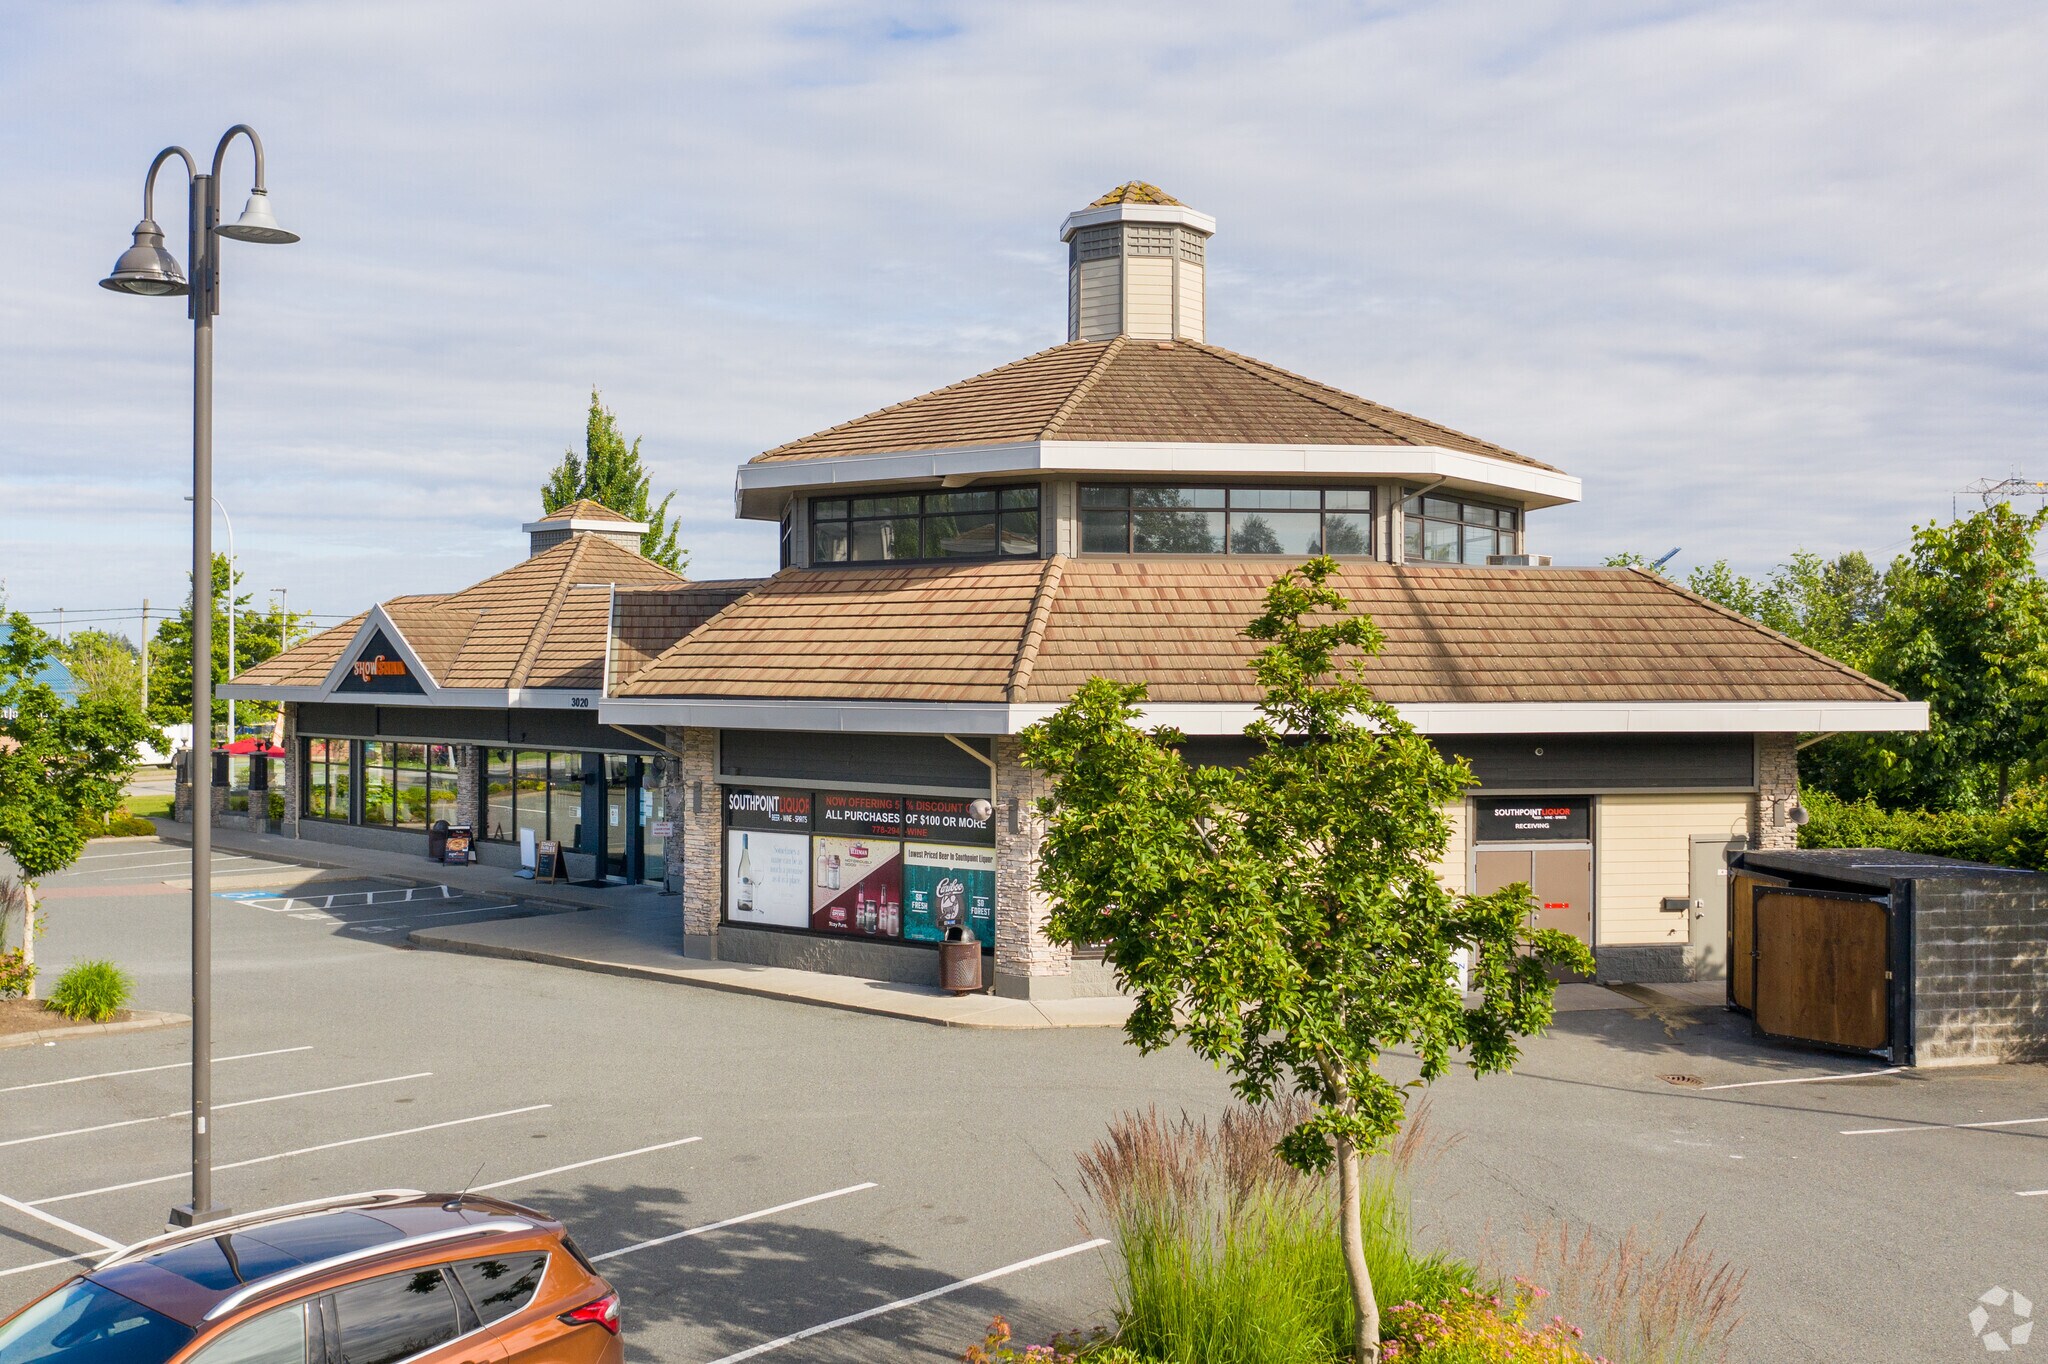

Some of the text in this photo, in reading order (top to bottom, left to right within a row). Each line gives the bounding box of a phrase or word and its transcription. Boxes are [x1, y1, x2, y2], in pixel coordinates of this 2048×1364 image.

[571, 697, 589, 707] 3020
[826, 796, 846, 807] NOW
[848, 797, 892, 809] OFFERING
[916, 801, 963, 813] DISCOUNT
[825, 809, 987, 829] ALL PURCHASES OF $100 OR MORE
[908, 849, 923, 858] Lowest
[924, 851, 938, 860] Priced
[939, 852, 949, 860] Beer
[955, 853, 978, 862] Southpoint
[979, 854, 993, 864] Liquor
[915, 893, 922, 901] SO
[912, 901, 928, 909] FRESH
[971, 907, 990, 916] FOREST
